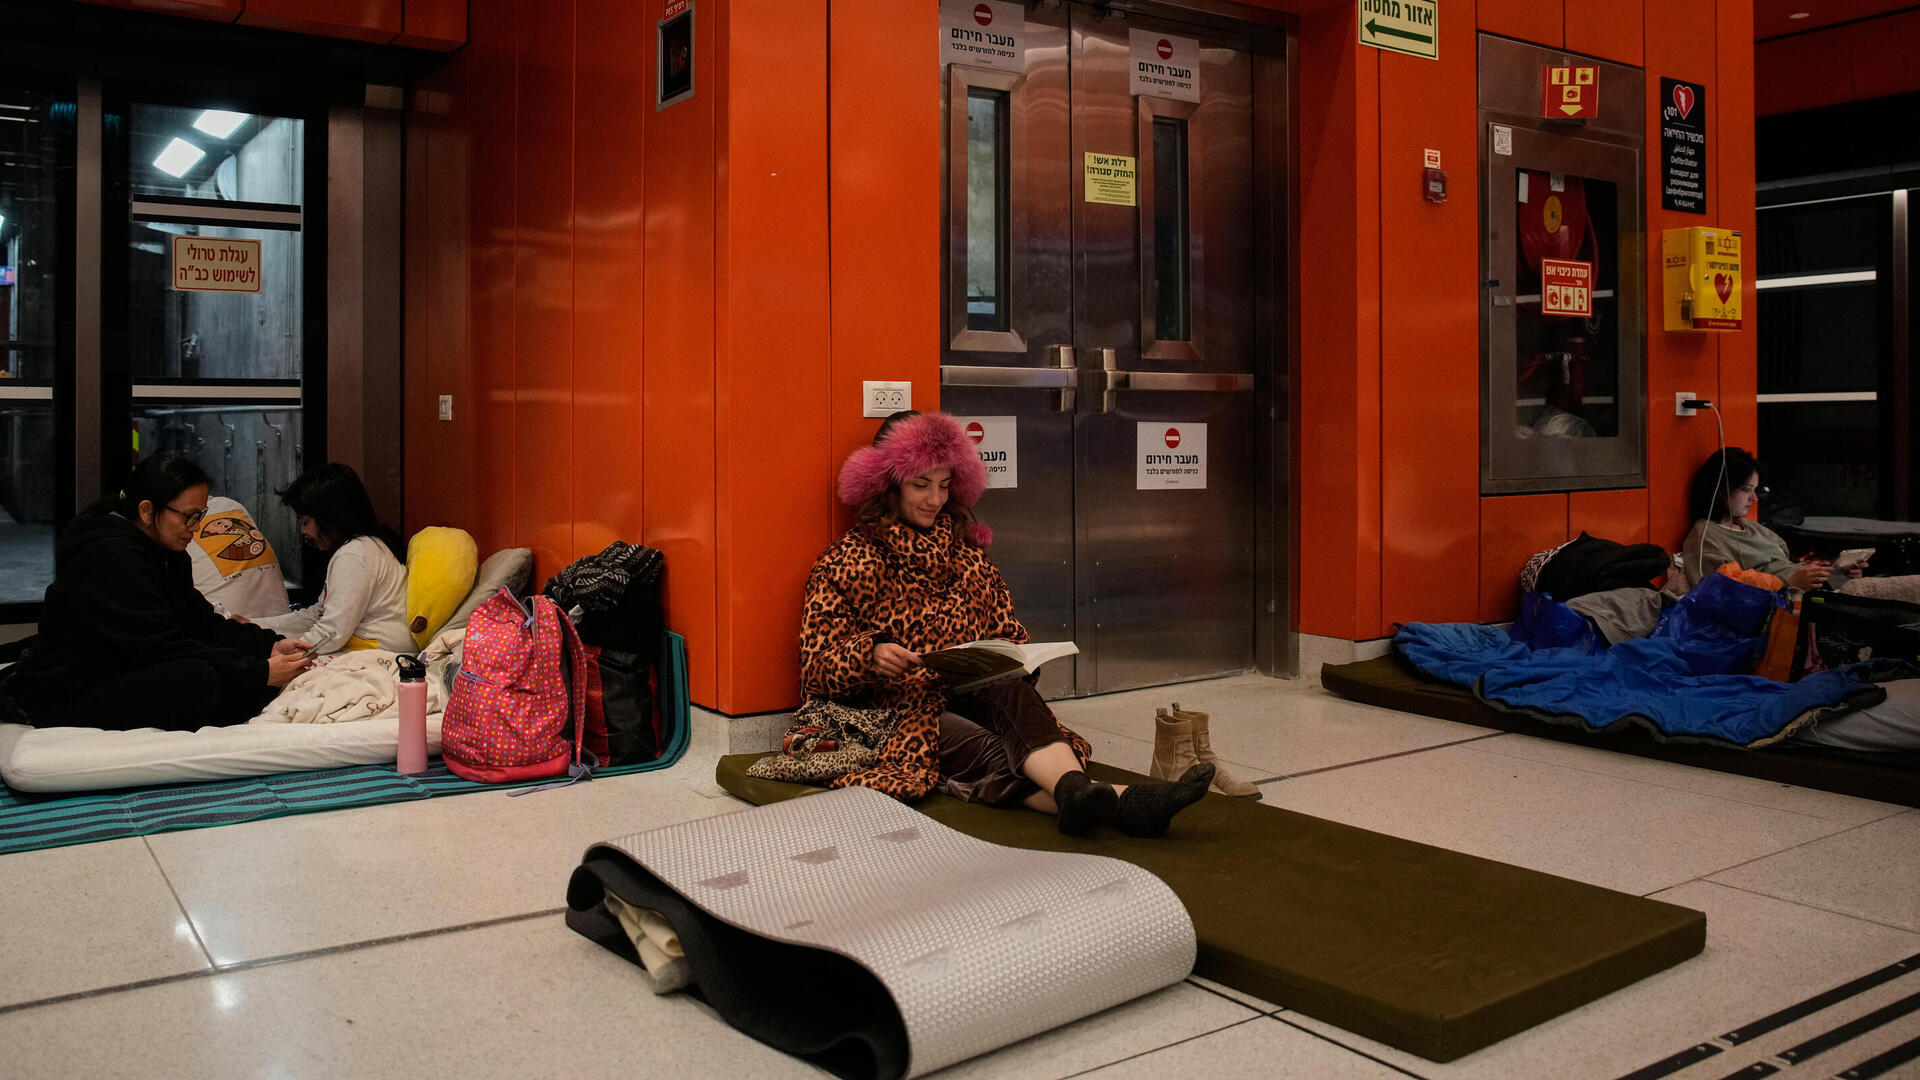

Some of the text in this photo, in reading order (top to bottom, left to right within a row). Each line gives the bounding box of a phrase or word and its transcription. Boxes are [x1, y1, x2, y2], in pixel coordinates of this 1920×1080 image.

[1404, 3, 1433, 26] אזור
[951, 28, 1015, 47] מעבר חירום
[951, 42, 1015, 58] כניסה למורשים בלבד
[1138, 62, 1191, 79] מעבר חירום
[1138, 75, 1152, 83] בלבד
[1153, 77, 1176, 86] למורשים
[1667, 106, 1678, 117] 101
[1664, 127, 1704, 144] מכשיר החייאה
[1093, 155, 1127, 167] דלת אש!
[1087, 165, 1134, 178] החזק סגורה!
[187, 243, 248, 264] עגלת טרולי
[213, 267, 255, 283] לשימוש
[1545, 265, 1556, 276] אש
[978, 451, 1007, 462] מעבר
[1145, 454, 1199, 465] מעבר חירום
[1145, 467, 1159, 475] בלבד
[1160, 467, 1183, 475] למורשים
